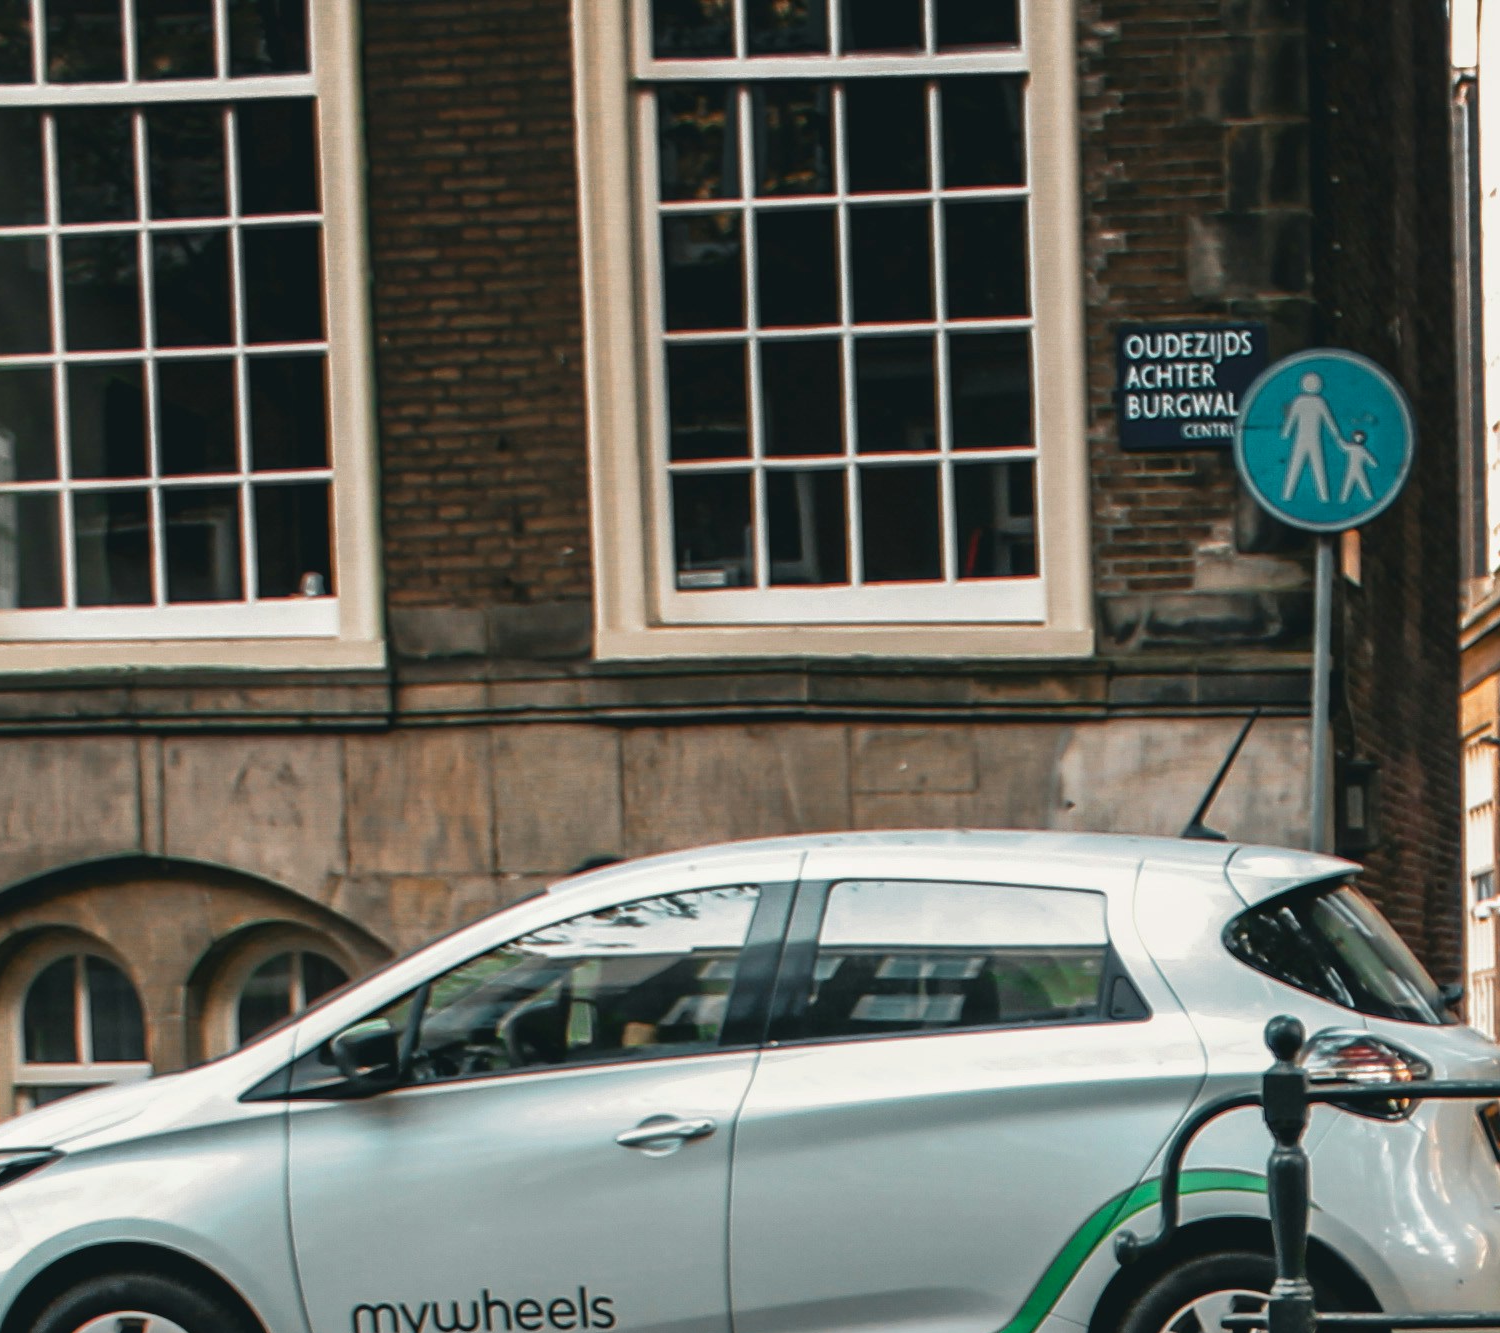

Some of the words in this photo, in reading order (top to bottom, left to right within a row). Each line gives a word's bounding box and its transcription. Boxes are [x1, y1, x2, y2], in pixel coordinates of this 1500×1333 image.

[1124, 331, 1253, 363] OUDEZIJDS
[1125, 363, 1217, 389] ACHTER
[1126, 391, 1239, 419] BURGWAL
